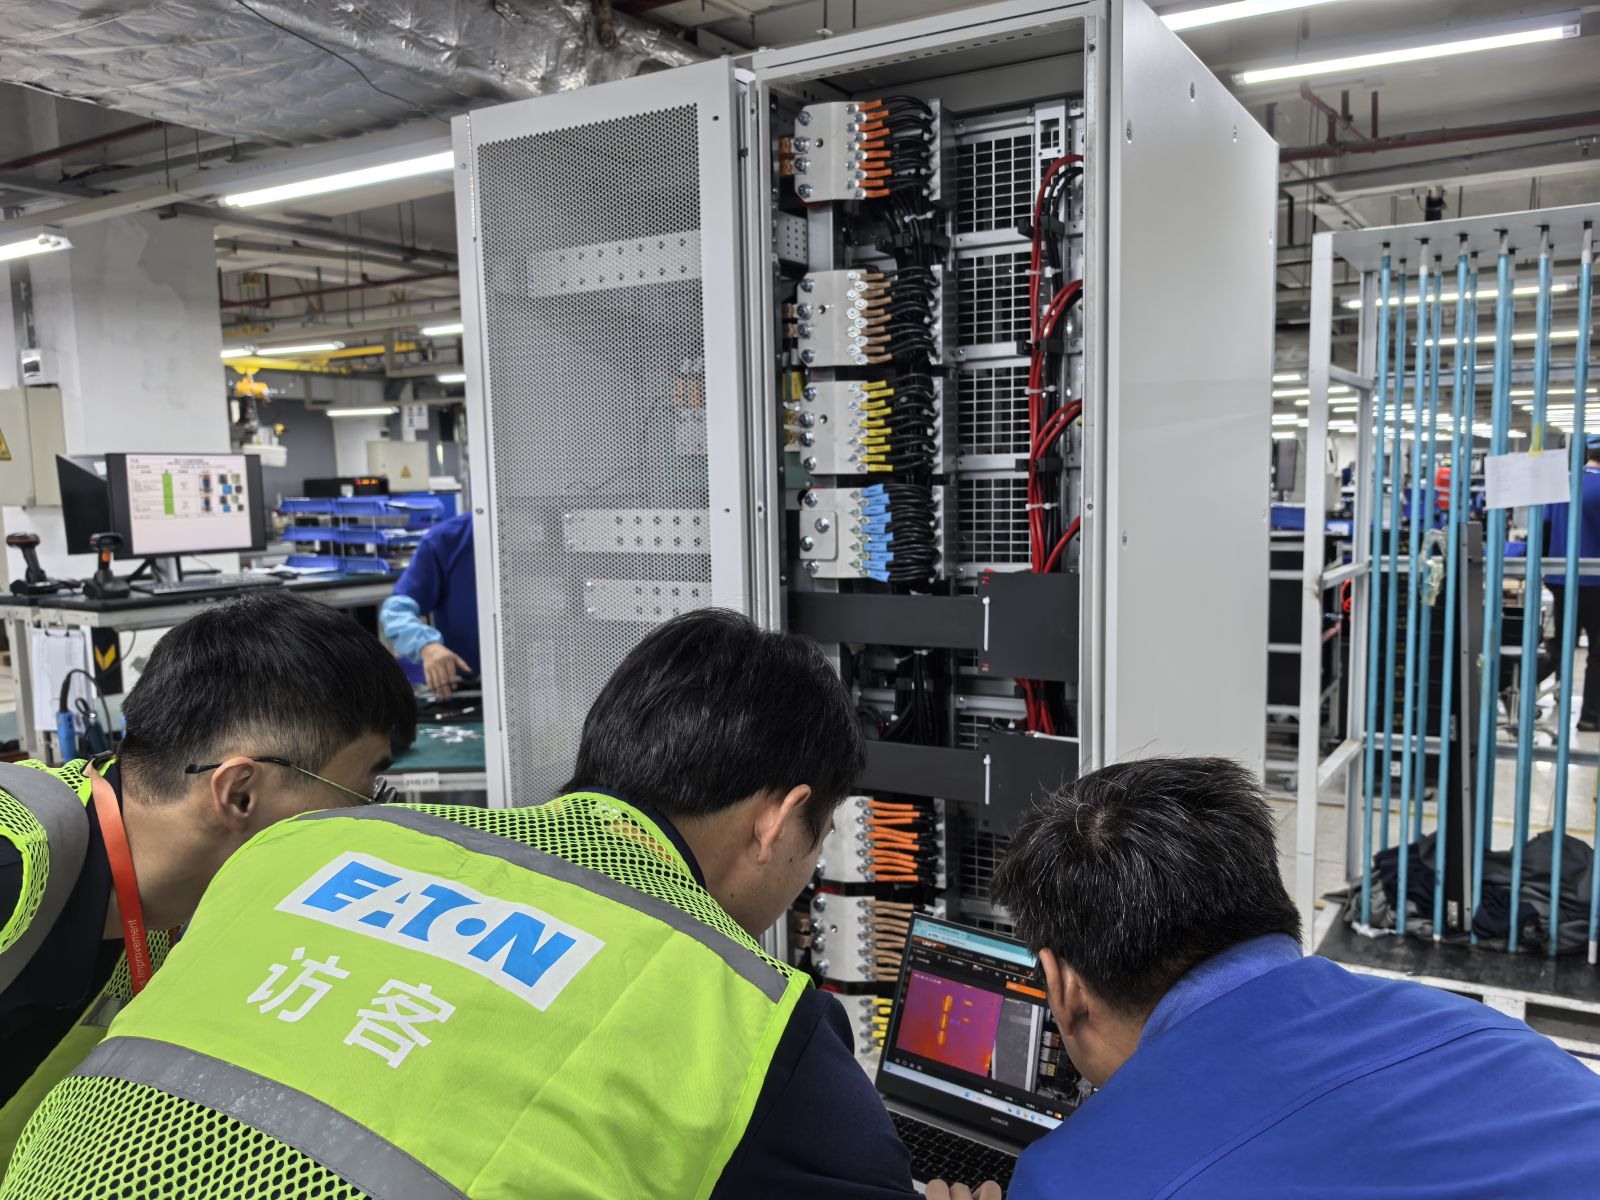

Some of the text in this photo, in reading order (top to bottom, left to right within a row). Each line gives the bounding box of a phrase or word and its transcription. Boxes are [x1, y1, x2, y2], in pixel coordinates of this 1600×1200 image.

[128, 919, 145, 979] Improvement
[302, 860, 577, 988] EATON
[247, 946, 456, 1069] 访客
